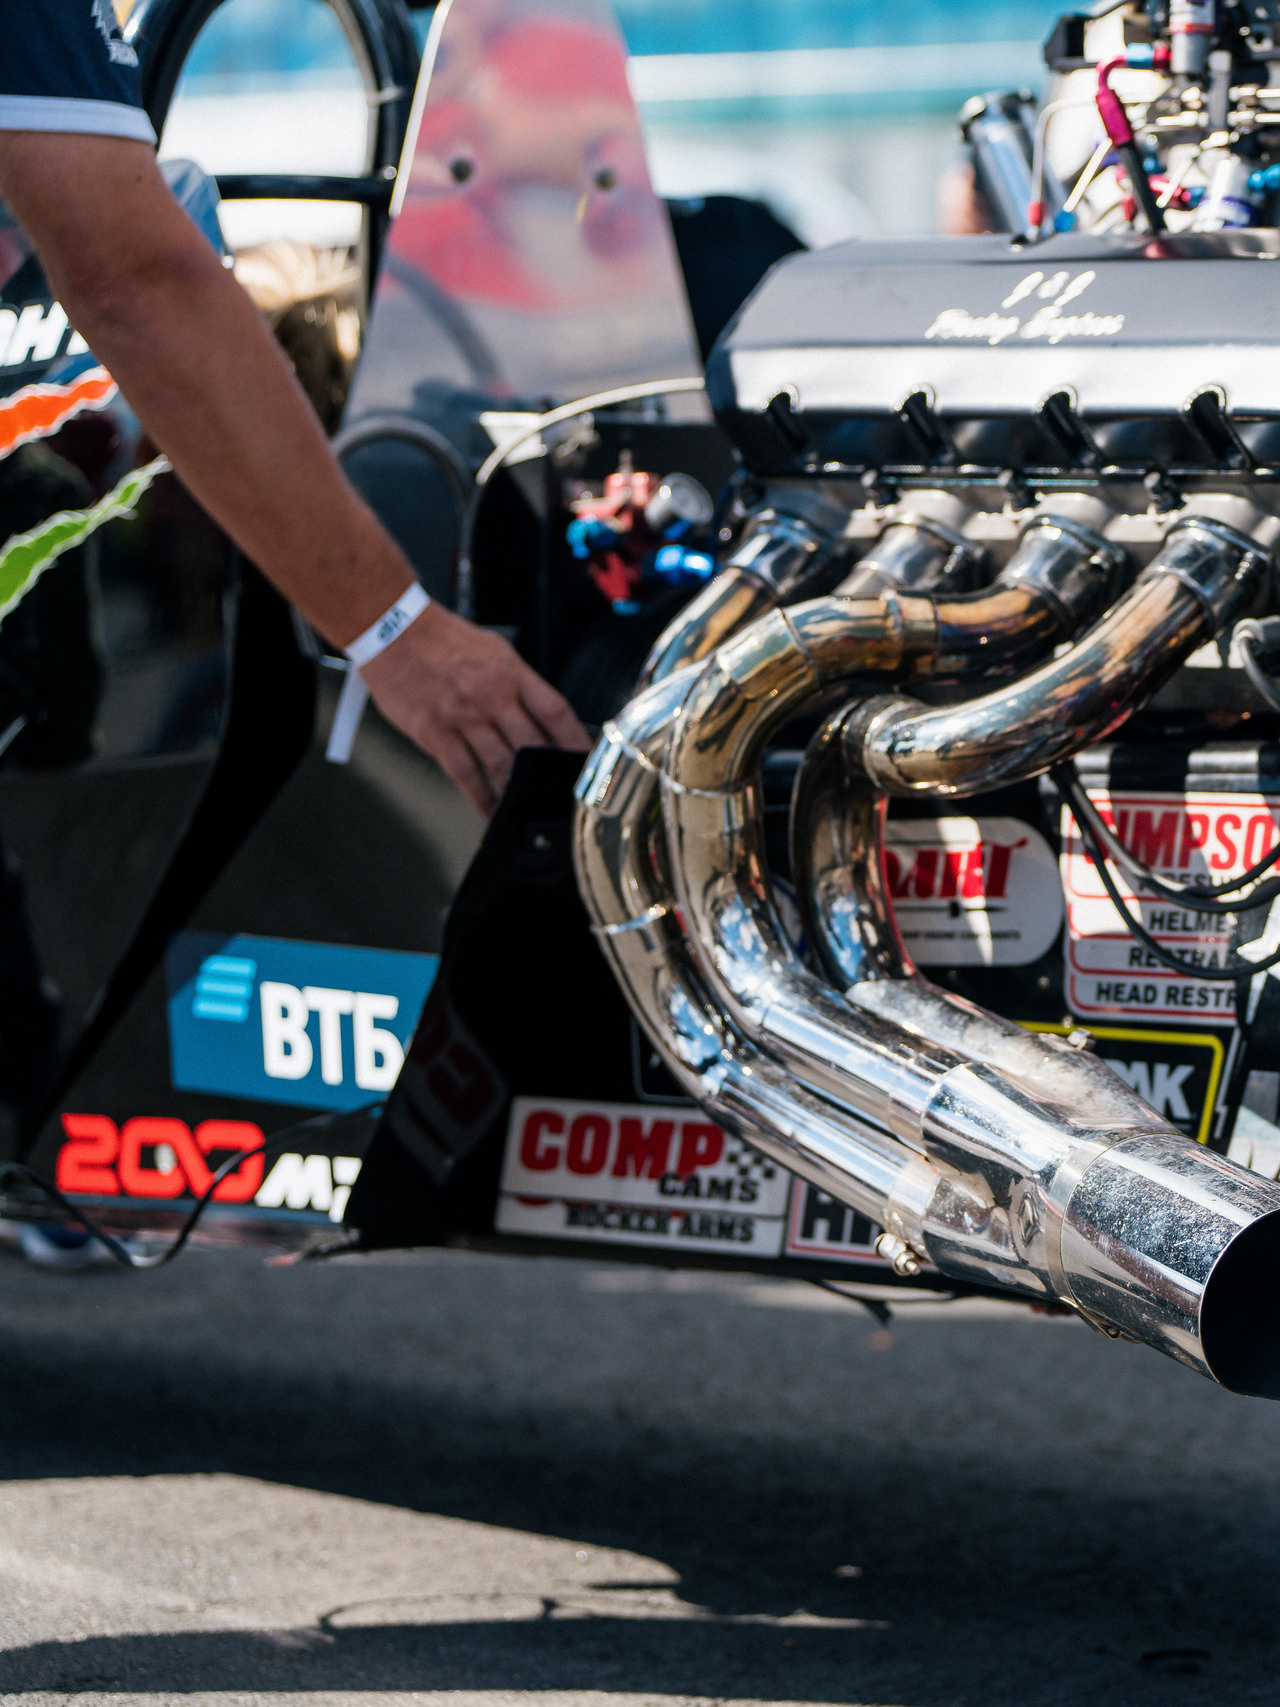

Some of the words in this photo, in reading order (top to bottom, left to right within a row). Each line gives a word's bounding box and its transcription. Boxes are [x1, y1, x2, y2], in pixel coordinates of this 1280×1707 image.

[1149, 912, 1227, 932] HELME
[1096, 982, 1157, 1003] HEAD
[1165, 987, 1236, 1009] RESTR
[260, 980, 405, 1091] ВТБ
[519, 1110, 725, 1180] COMP
[657, 1171, 759, 1204] CAMS
